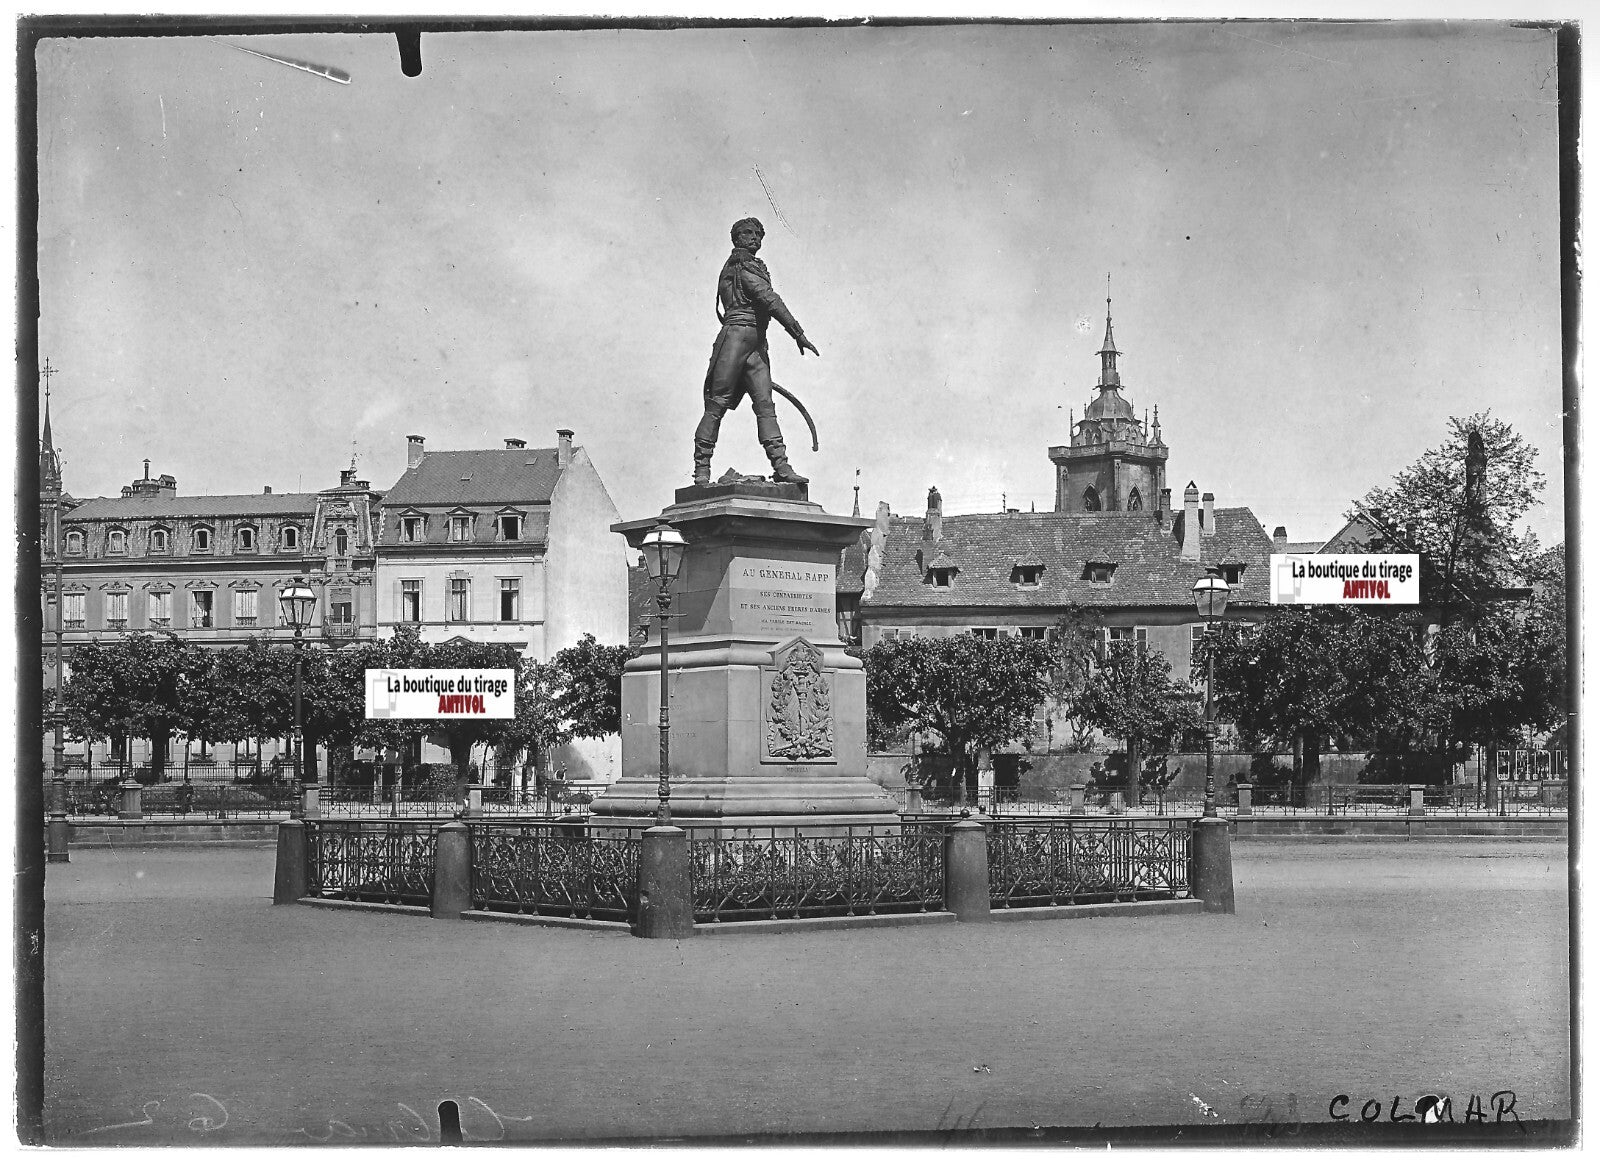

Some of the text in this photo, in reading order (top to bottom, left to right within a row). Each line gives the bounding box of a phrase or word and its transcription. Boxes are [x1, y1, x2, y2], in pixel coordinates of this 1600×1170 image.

[742, 567, 756, 577] AU
[805, 572, 829, 583] RAPP
[1328, 1089, 1527, 1135] COLMAR
